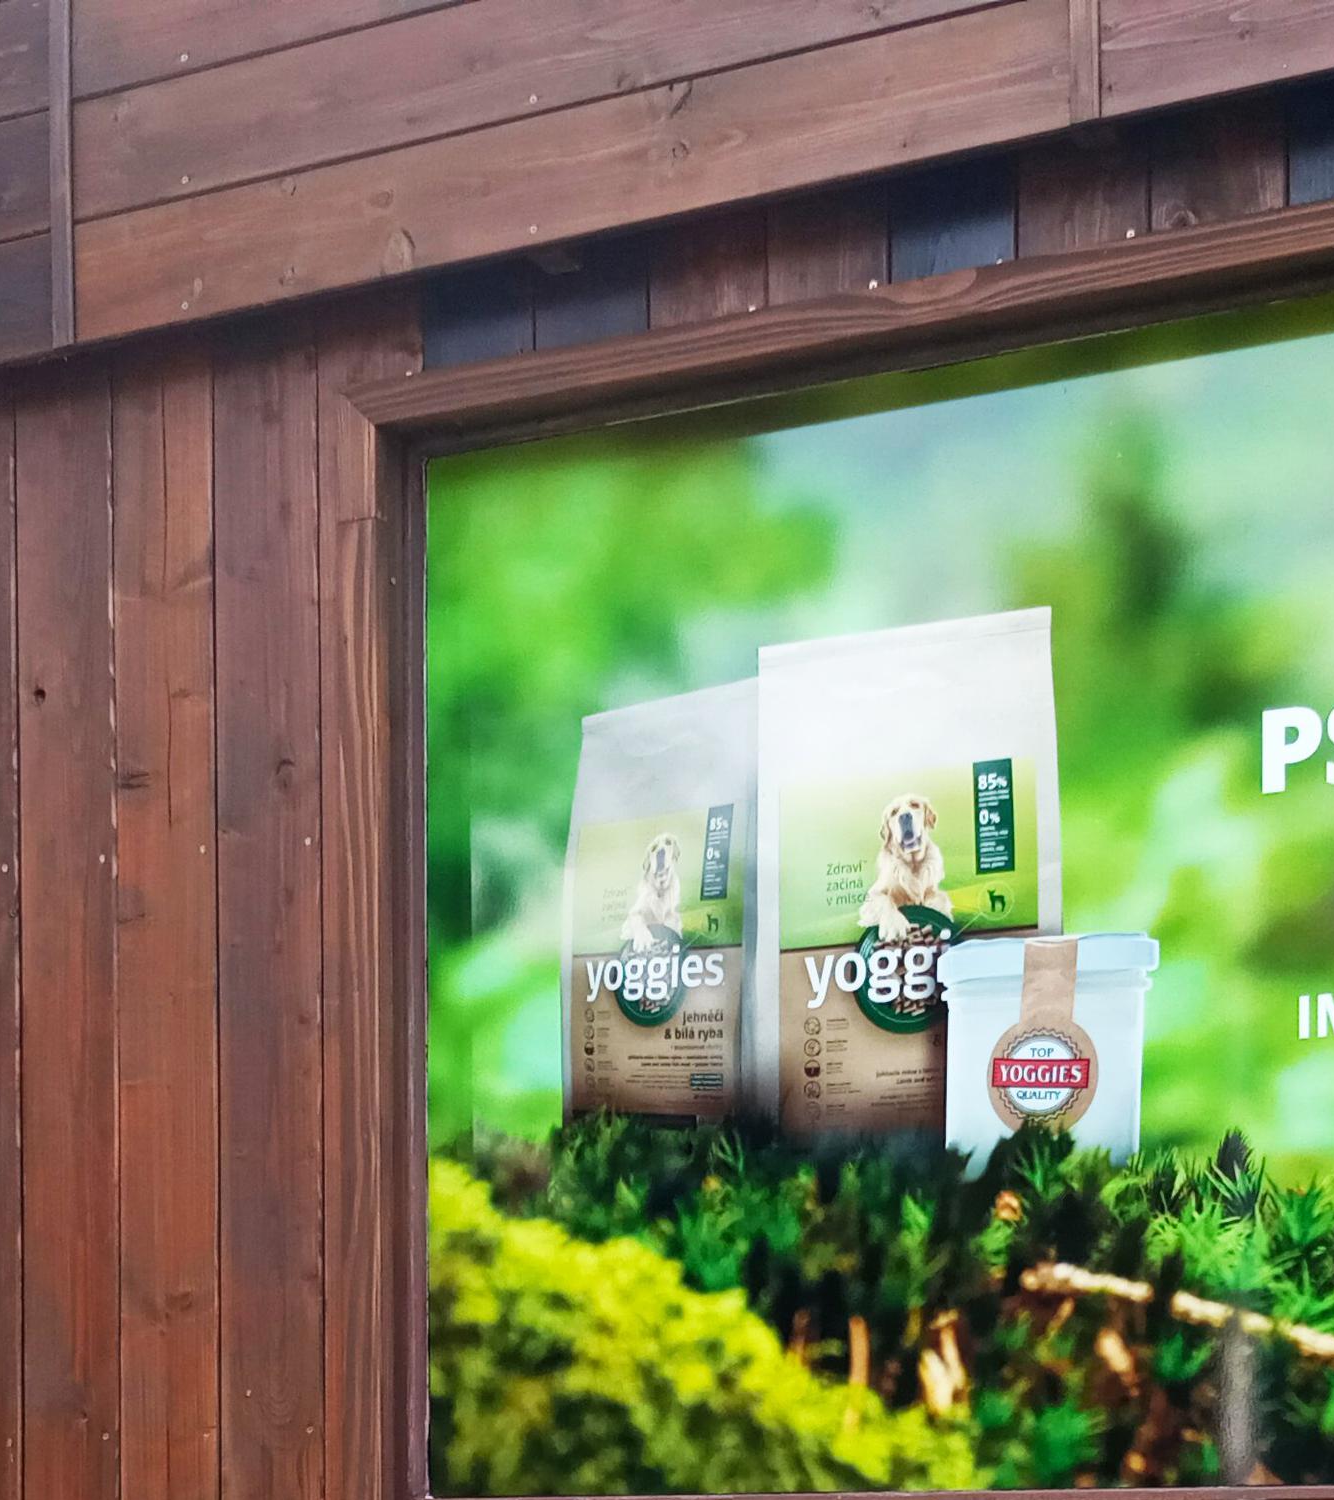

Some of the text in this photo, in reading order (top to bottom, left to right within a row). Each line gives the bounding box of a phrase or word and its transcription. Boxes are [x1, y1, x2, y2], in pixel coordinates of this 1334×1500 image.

[977, 772, 1008, 790] 85%
[979, 809, 1001, 825] 0%
[586, 943, 725, 1003] yoggies
[664, 1026, 724, 1043] & bílá ryba
[1029, 1047, 1055, 1058] TOP
[1000, 1064, 1083, 1083] YOGGIES
[1016, 1090, 1062, 1101] QUALITY
